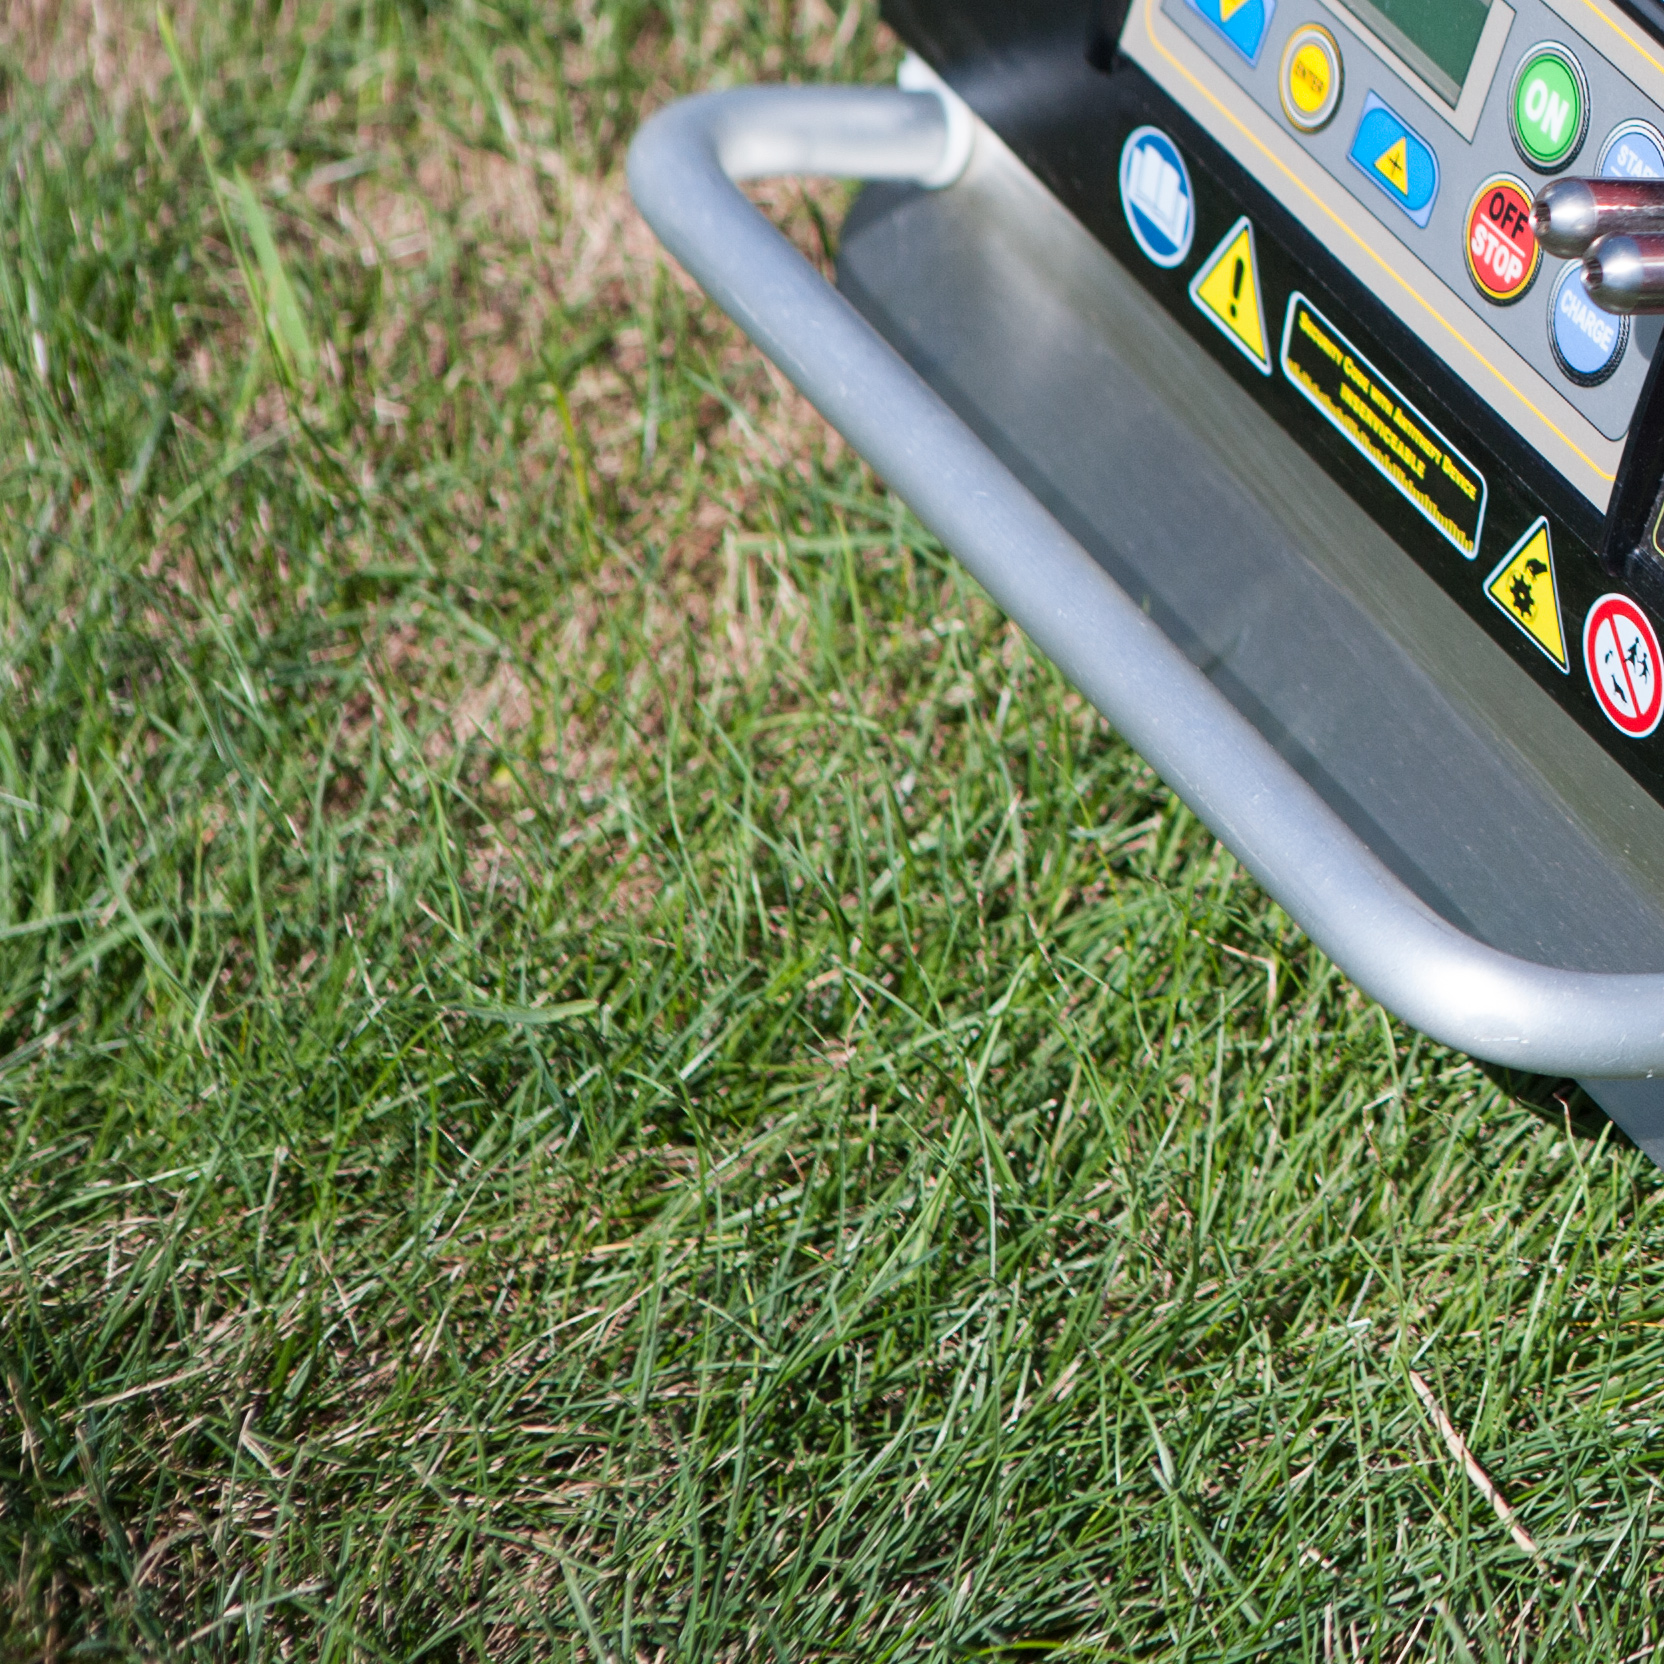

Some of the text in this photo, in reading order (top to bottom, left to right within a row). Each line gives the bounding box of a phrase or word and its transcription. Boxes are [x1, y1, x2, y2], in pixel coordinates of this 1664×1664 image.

[1524, 78, 1570, 143] ON
[1489, 191, 1530, 238] OFF
[1471, 223, 1523, 284] STOP
[1560, 289, 1615, 353] CHARGE
